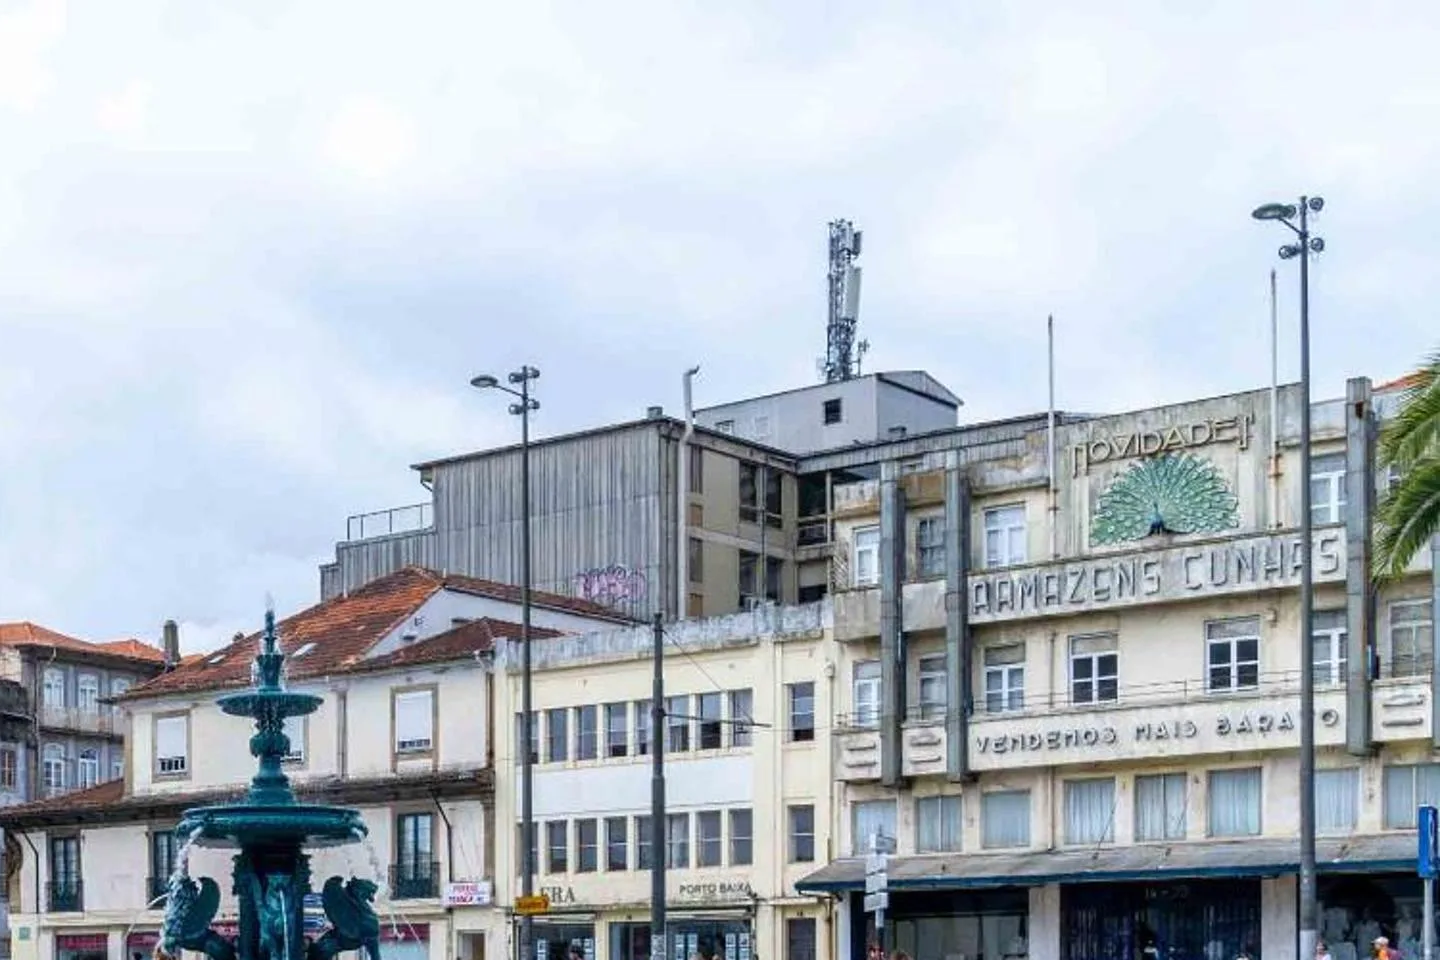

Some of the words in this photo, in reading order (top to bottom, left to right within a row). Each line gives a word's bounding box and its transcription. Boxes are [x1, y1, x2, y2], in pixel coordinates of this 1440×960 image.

[976, 727, 1117, 754] VENDEMOS
[1136, 720, 1197, 741] MAIS
[1216, 708, 1339, 737] BARAO
[679, 884, 717, 894] PORTO
[720, 882, 752, 894] BAIXA
